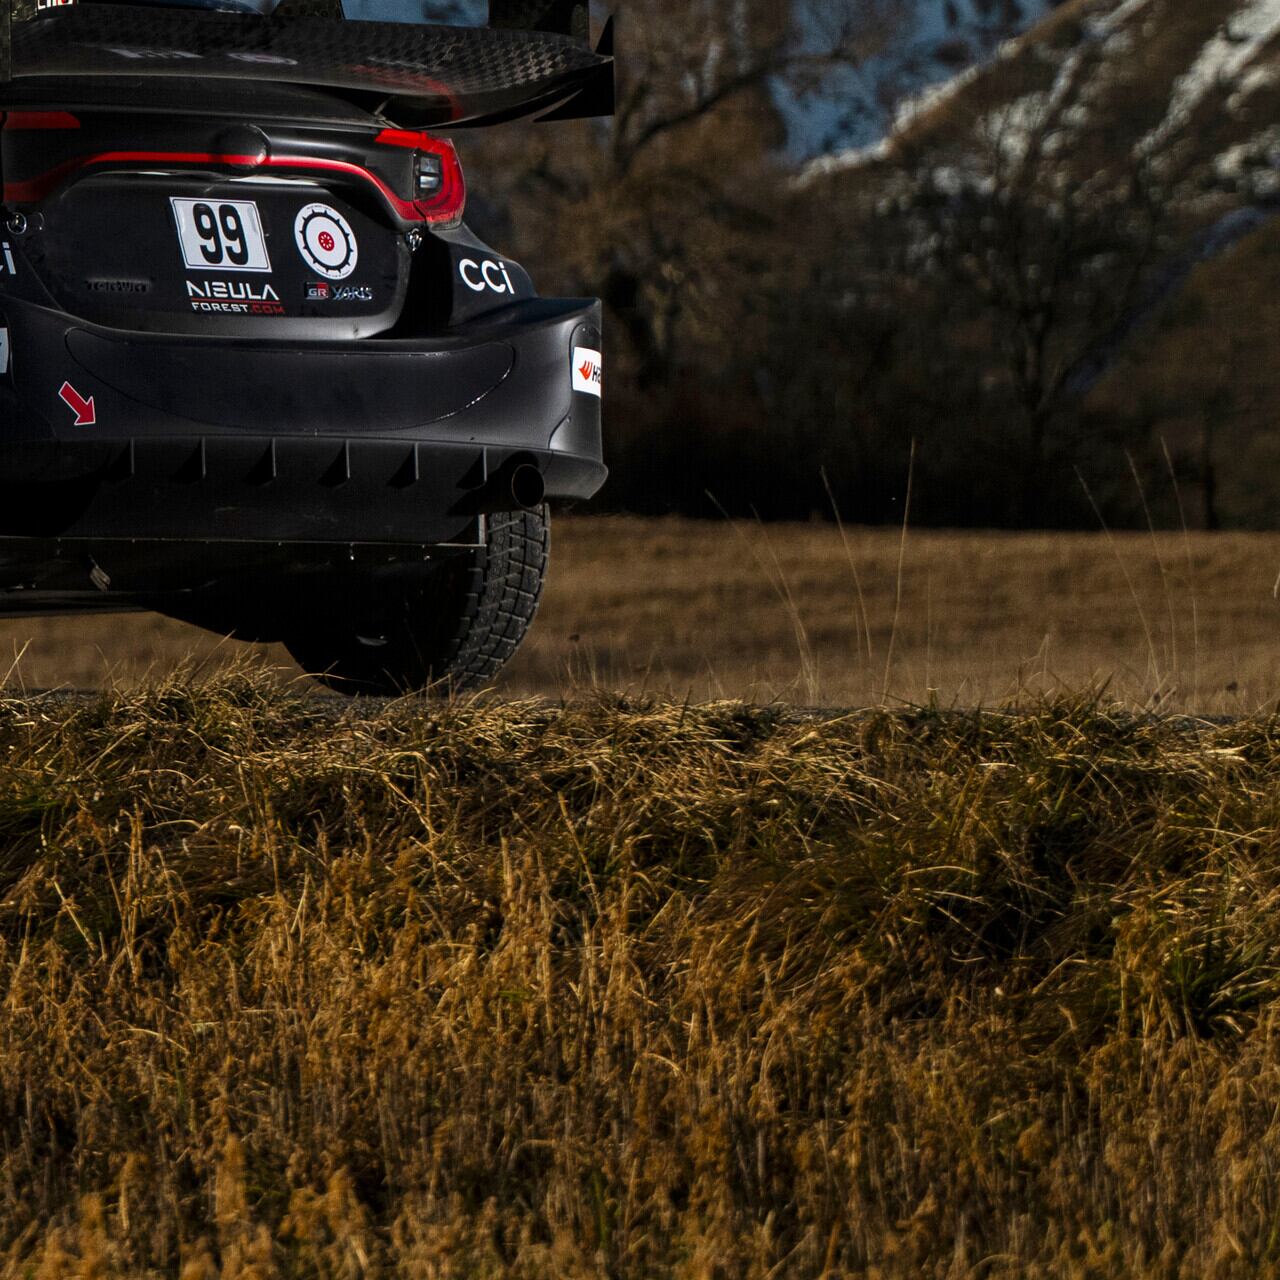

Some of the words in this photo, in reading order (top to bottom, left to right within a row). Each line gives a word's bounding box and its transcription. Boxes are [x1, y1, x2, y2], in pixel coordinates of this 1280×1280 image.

[193, 202, 249, 265] 99
[308, 287, 328, 298] GR
[331, 285, 373, 301] YARIS
